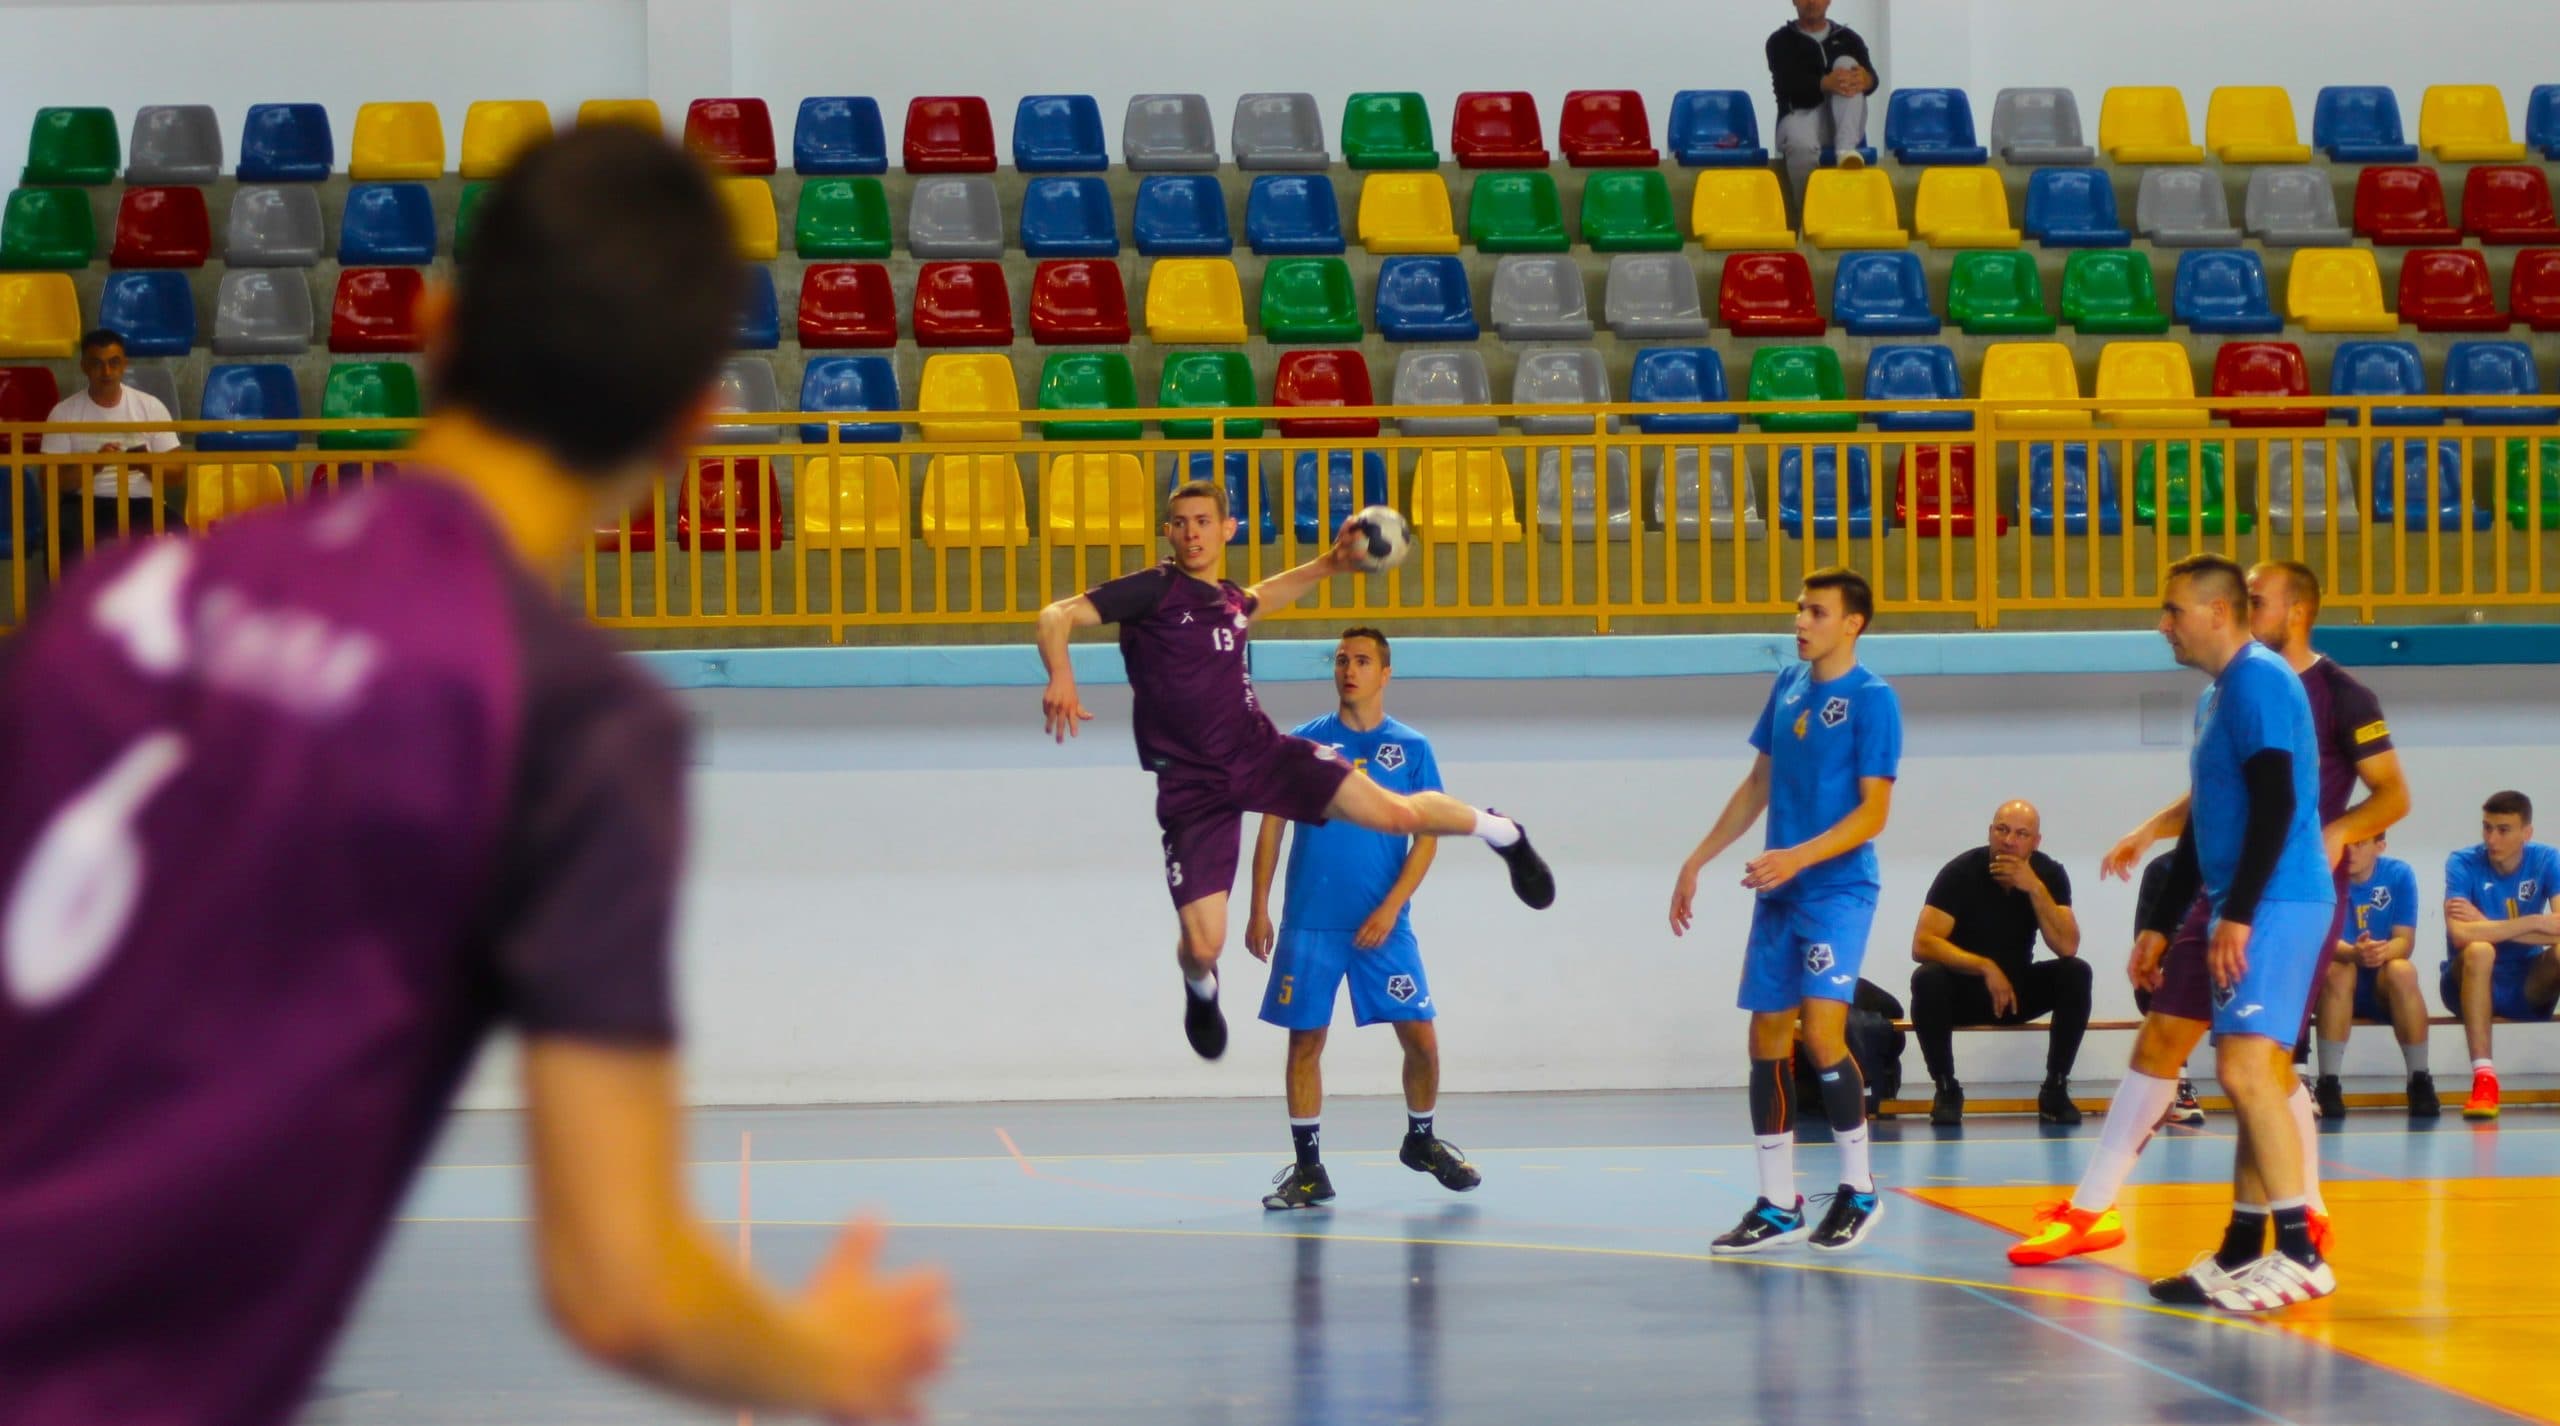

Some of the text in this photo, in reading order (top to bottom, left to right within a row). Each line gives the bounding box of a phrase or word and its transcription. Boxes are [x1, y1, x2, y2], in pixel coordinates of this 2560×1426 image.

[1212, 627, 1235, 651] 13
[1793, 709, 1811, 740] 4
[4, 732, 190, 1008] 6
[1278, 975, 1295, 1005] 5
